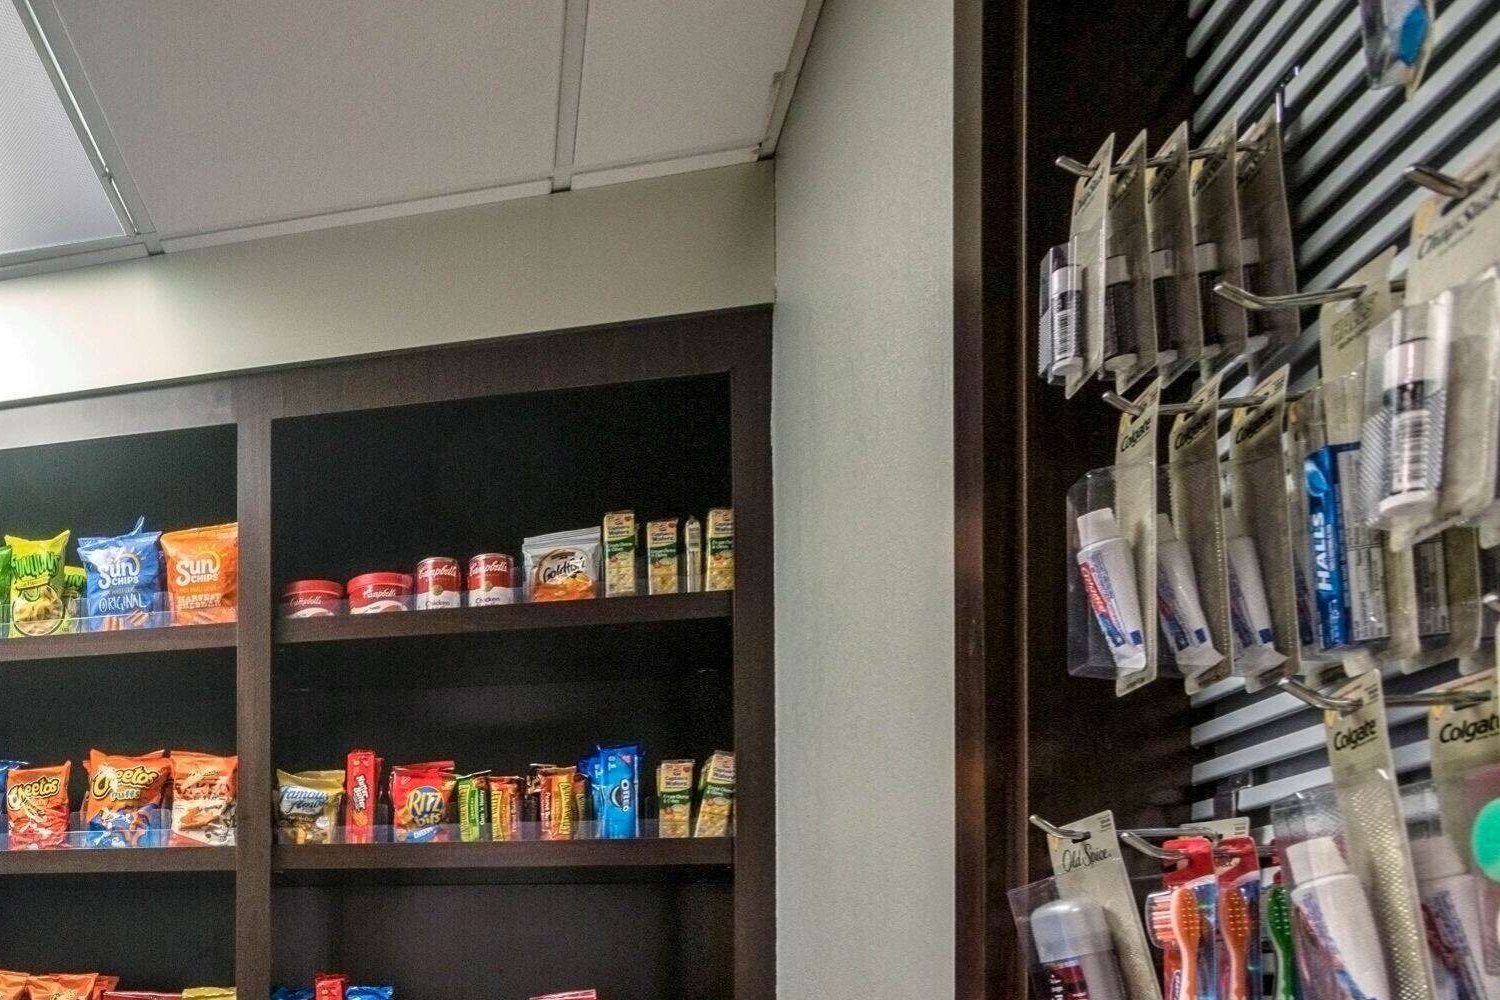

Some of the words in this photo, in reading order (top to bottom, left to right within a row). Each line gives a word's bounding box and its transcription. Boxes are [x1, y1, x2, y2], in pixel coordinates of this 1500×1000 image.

[1312, 511, 1334, 591] HALLS
[98, 560, 141, 590] Sun
[111, 576, 140, 587] CHIPS
[176, 556, 221, 587] Sun
[190, 573, 220, 583] CHIPS
[417, 565, 458, 579] Campbell's
[469, 560, 509, 576] Campbell's
[98, 593, 147, 613] ORIGINAL
[1333, 717, 1377, 752] Colgate
[7, 777, 61, 811] Cheetos
[91, 765, 160, 800] Cheetos
[620, 778, 631, 812] OREO
[407, 789, 445, 817] RITZ
[1061, 849, 1082, 873] Old
[1083, 843, 1108, 867] Spice
